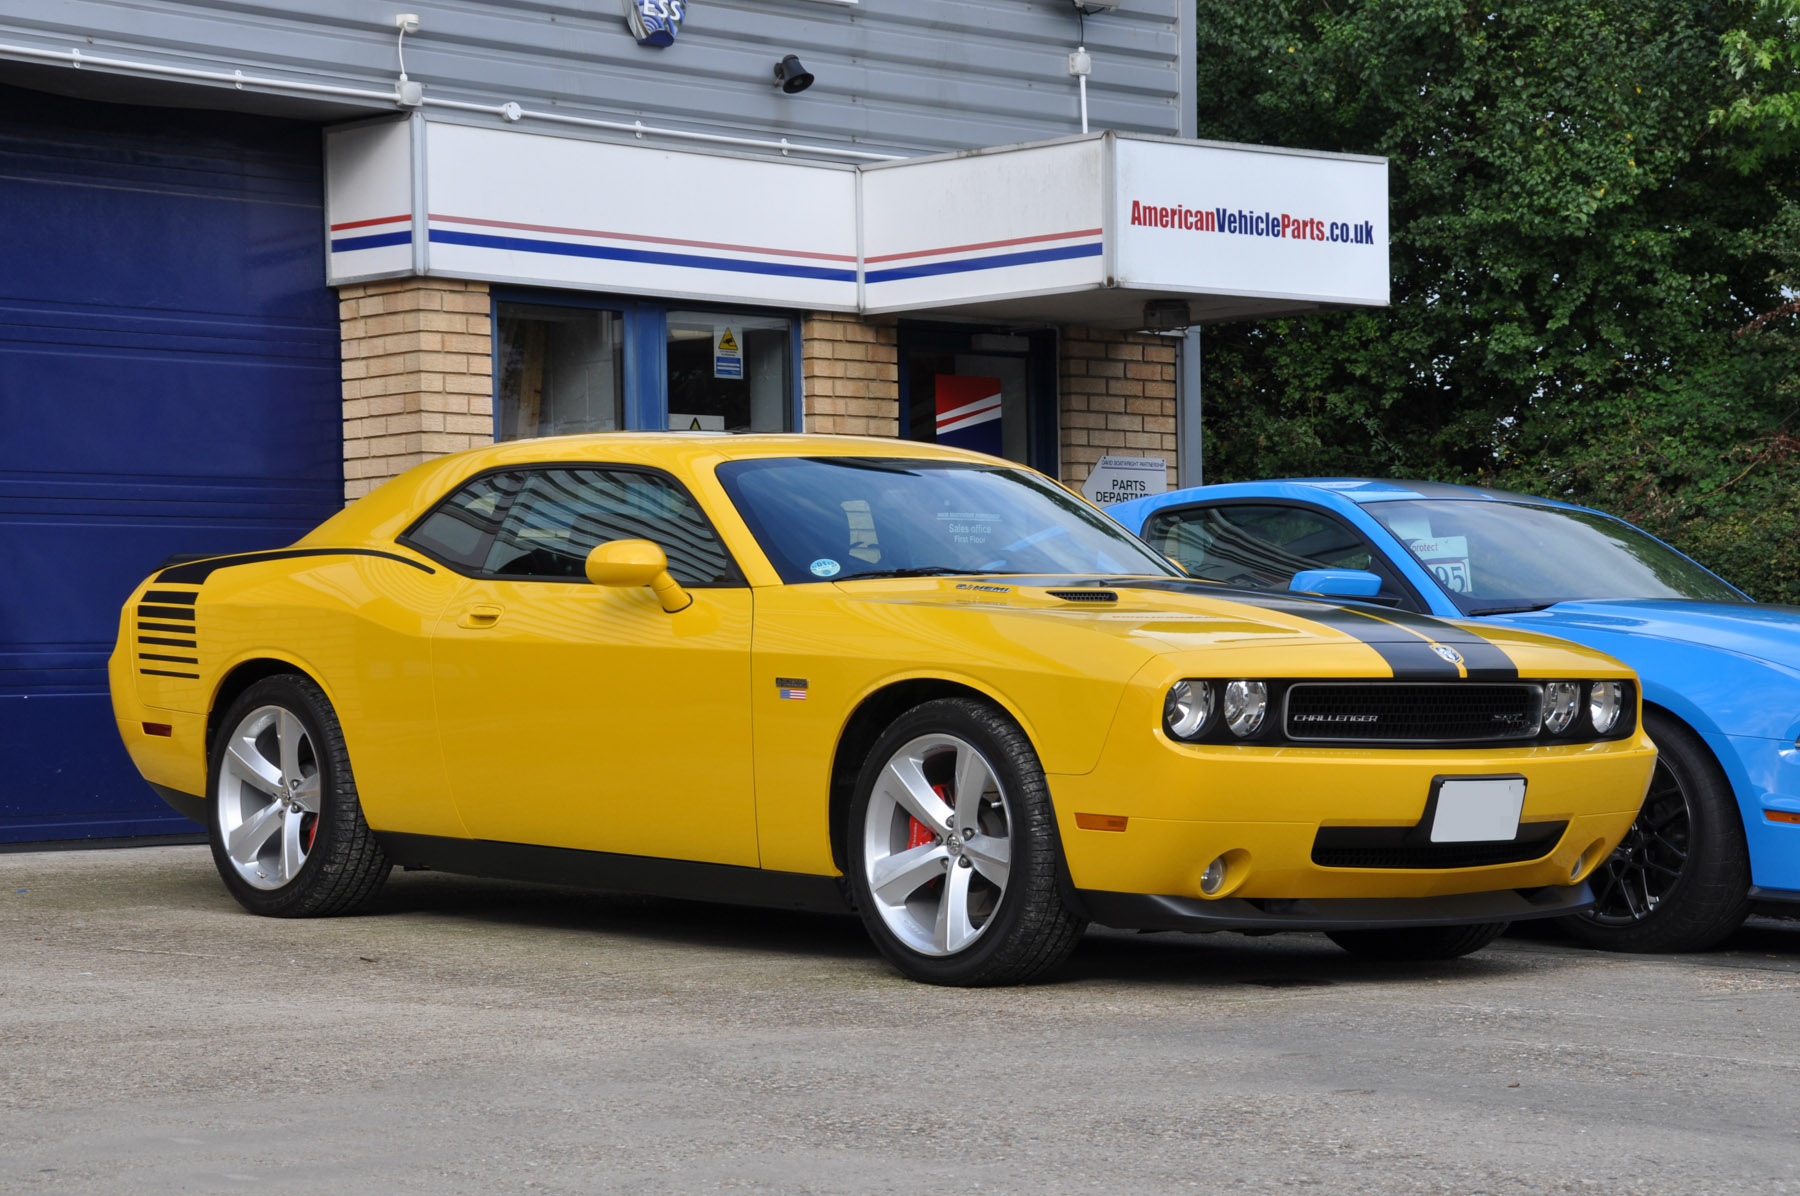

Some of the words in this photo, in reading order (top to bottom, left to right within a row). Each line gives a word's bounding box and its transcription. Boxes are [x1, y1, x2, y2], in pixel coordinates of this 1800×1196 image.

[1130, 199, 1374, 245] AmericanVehicleParts.co.uk
[1112, 479, 1146, 491] PARTS
[1096, 491, 1152, 503] DEPART
[948, 523, 969, 533] Sales
[970, 523, 992, 534] office
[969, 535, 986, 544] Floor
[1293, 714, 1379, 722] CHALLENGER
